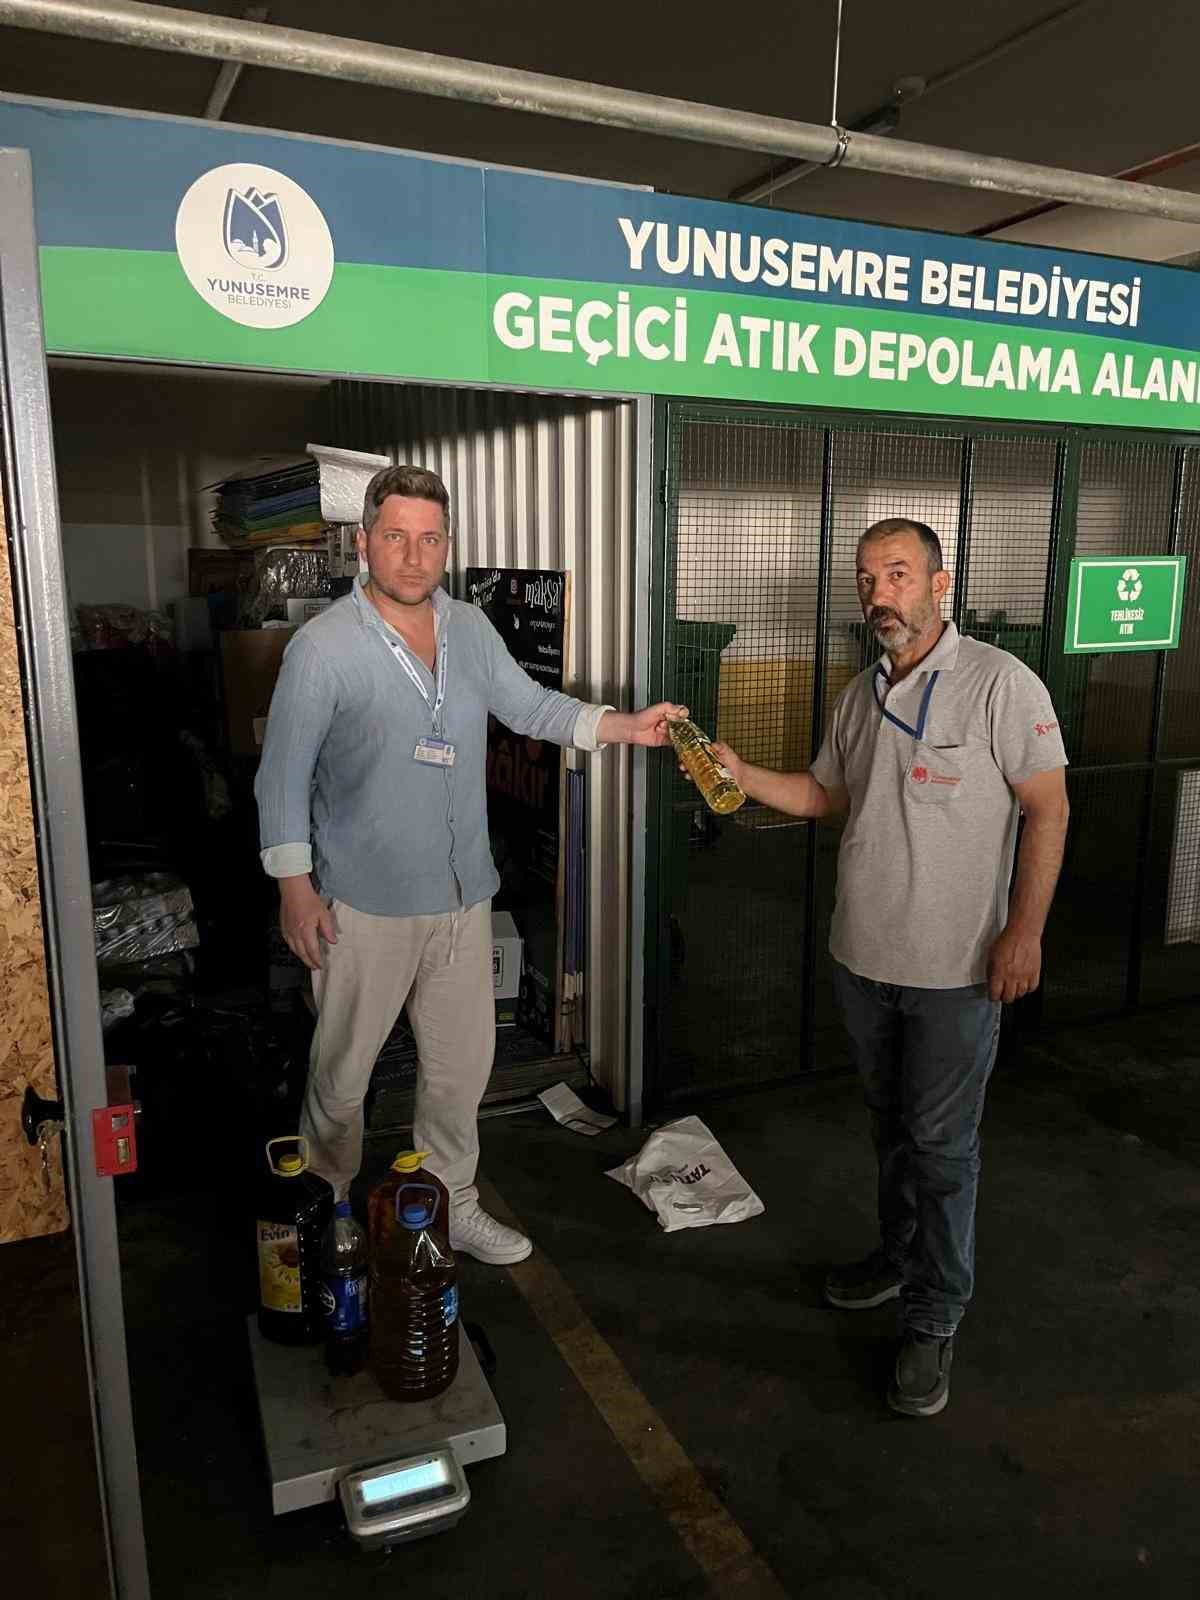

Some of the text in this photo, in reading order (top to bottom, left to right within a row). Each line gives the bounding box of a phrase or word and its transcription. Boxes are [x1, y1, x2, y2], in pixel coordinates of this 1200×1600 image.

[207, 278, 311, 300] YUNUSEMRE
[227, 294, 292, 309] BELEDİYESİ
[617, 217, 1141, 327] YUNUSEMRE BELEDİYESİ
[493, 290, 688, 367] GEÇİCİ
[703, 312, 821, 374] ATIK
[833, 327, 1082, 395] DEPOLAMA
